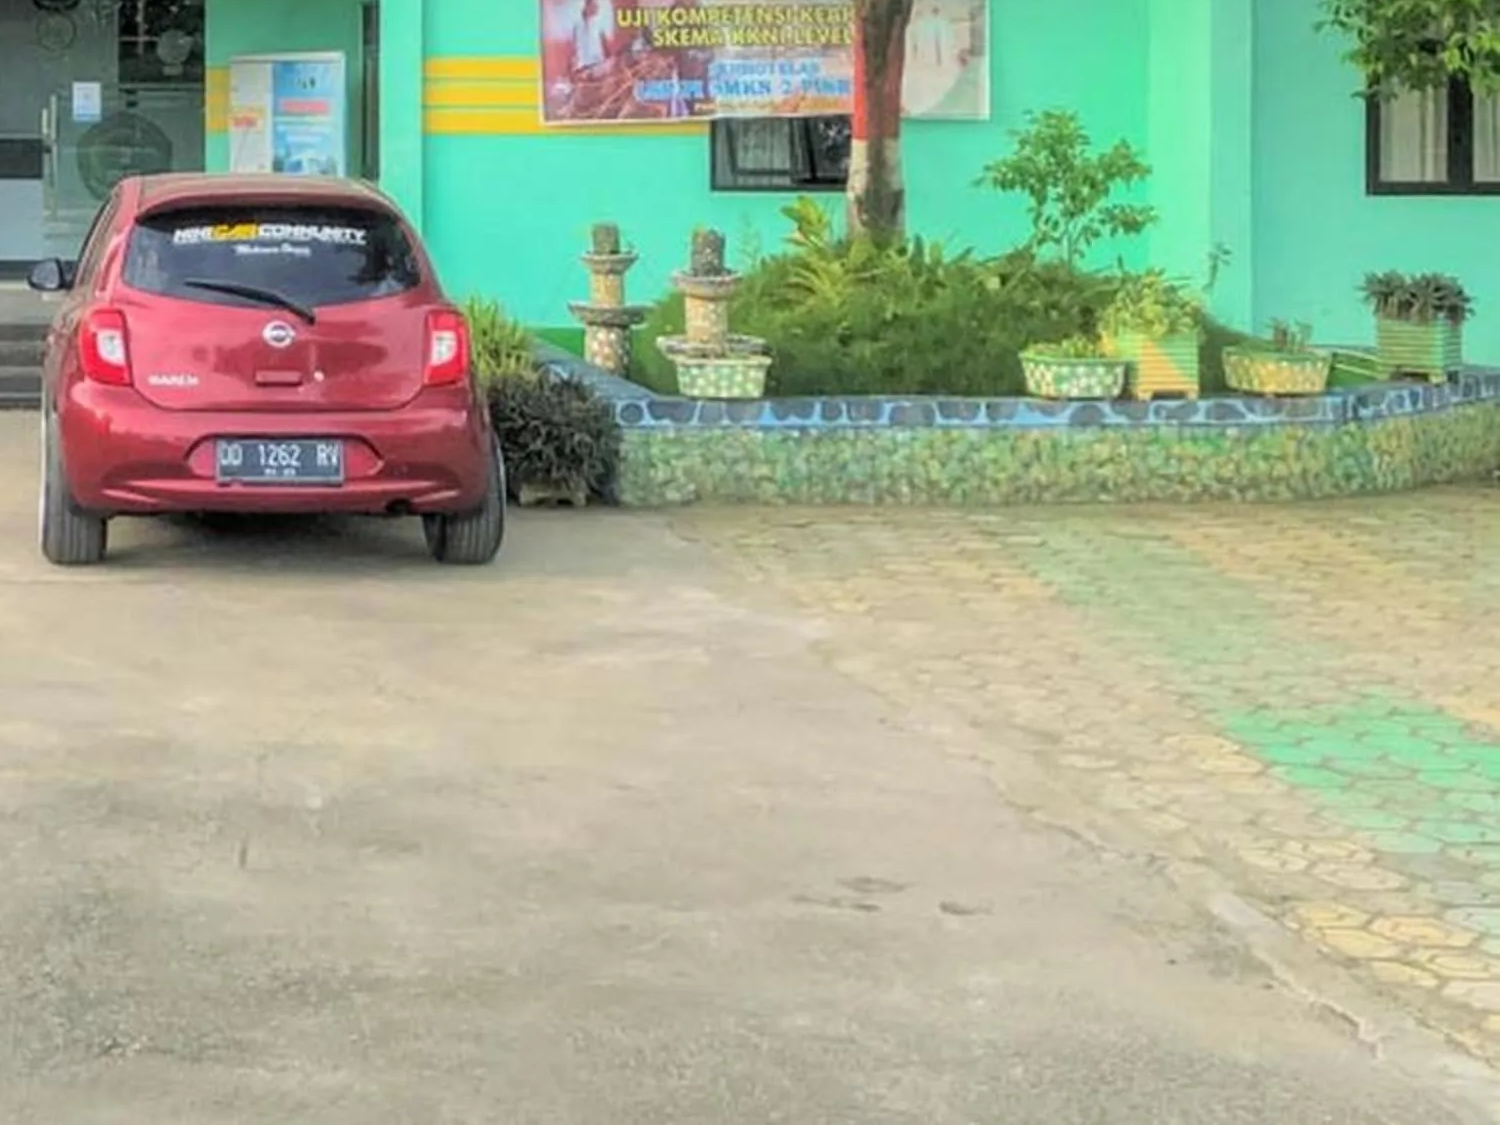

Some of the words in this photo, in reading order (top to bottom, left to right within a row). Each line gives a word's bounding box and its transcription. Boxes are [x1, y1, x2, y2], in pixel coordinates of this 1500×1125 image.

[616, 8, 647, 27] UJI
[657, 5, 793, 26] KOMPETENSI
[652, 27, 723, 48] SKEMA
[258, 224, 367, 245] COMMUNITY
[259, 442, 301, 467] 1262
[316, 442, 338, 467] RV
